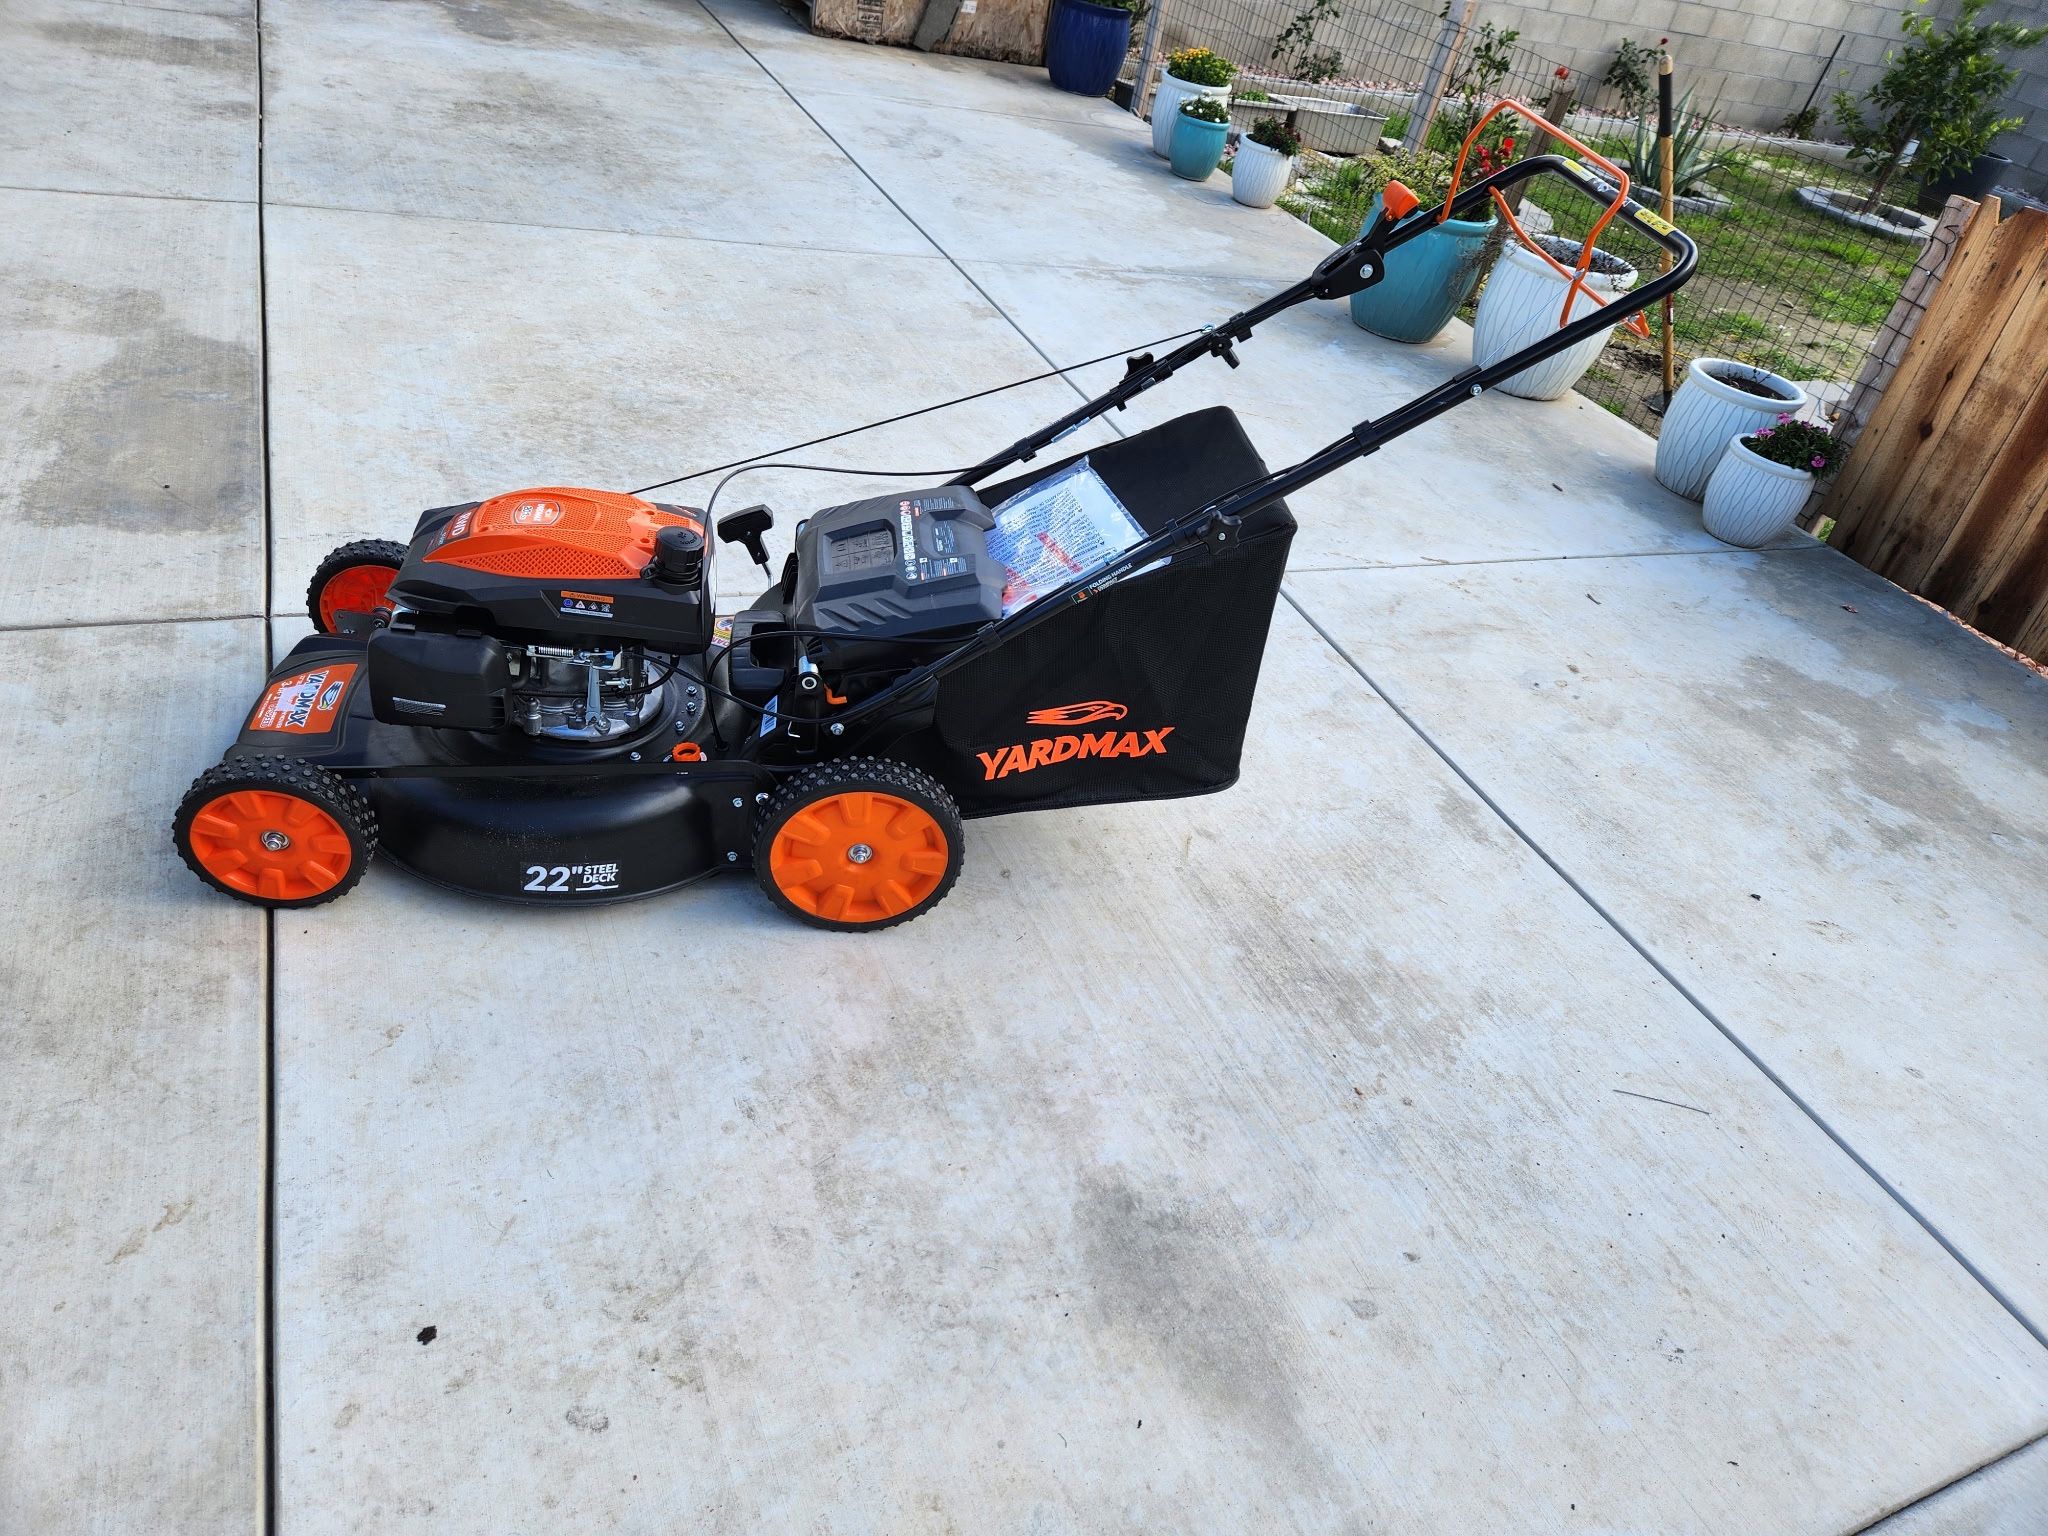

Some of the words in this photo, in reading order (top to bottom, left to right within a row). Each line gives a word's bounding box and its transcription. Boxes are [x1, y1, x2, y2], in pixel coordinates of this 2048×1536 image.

[1089, 575, 1112, 591] FOLDING
[1110, 562, 1133, 578] HANDLE
[976, 726, 1175, 781] YARDMAX
[523, 865, 583, 892] 22"
[582, 872, 616, 885] DECK
[584, 863, 619, 875] STEEL
